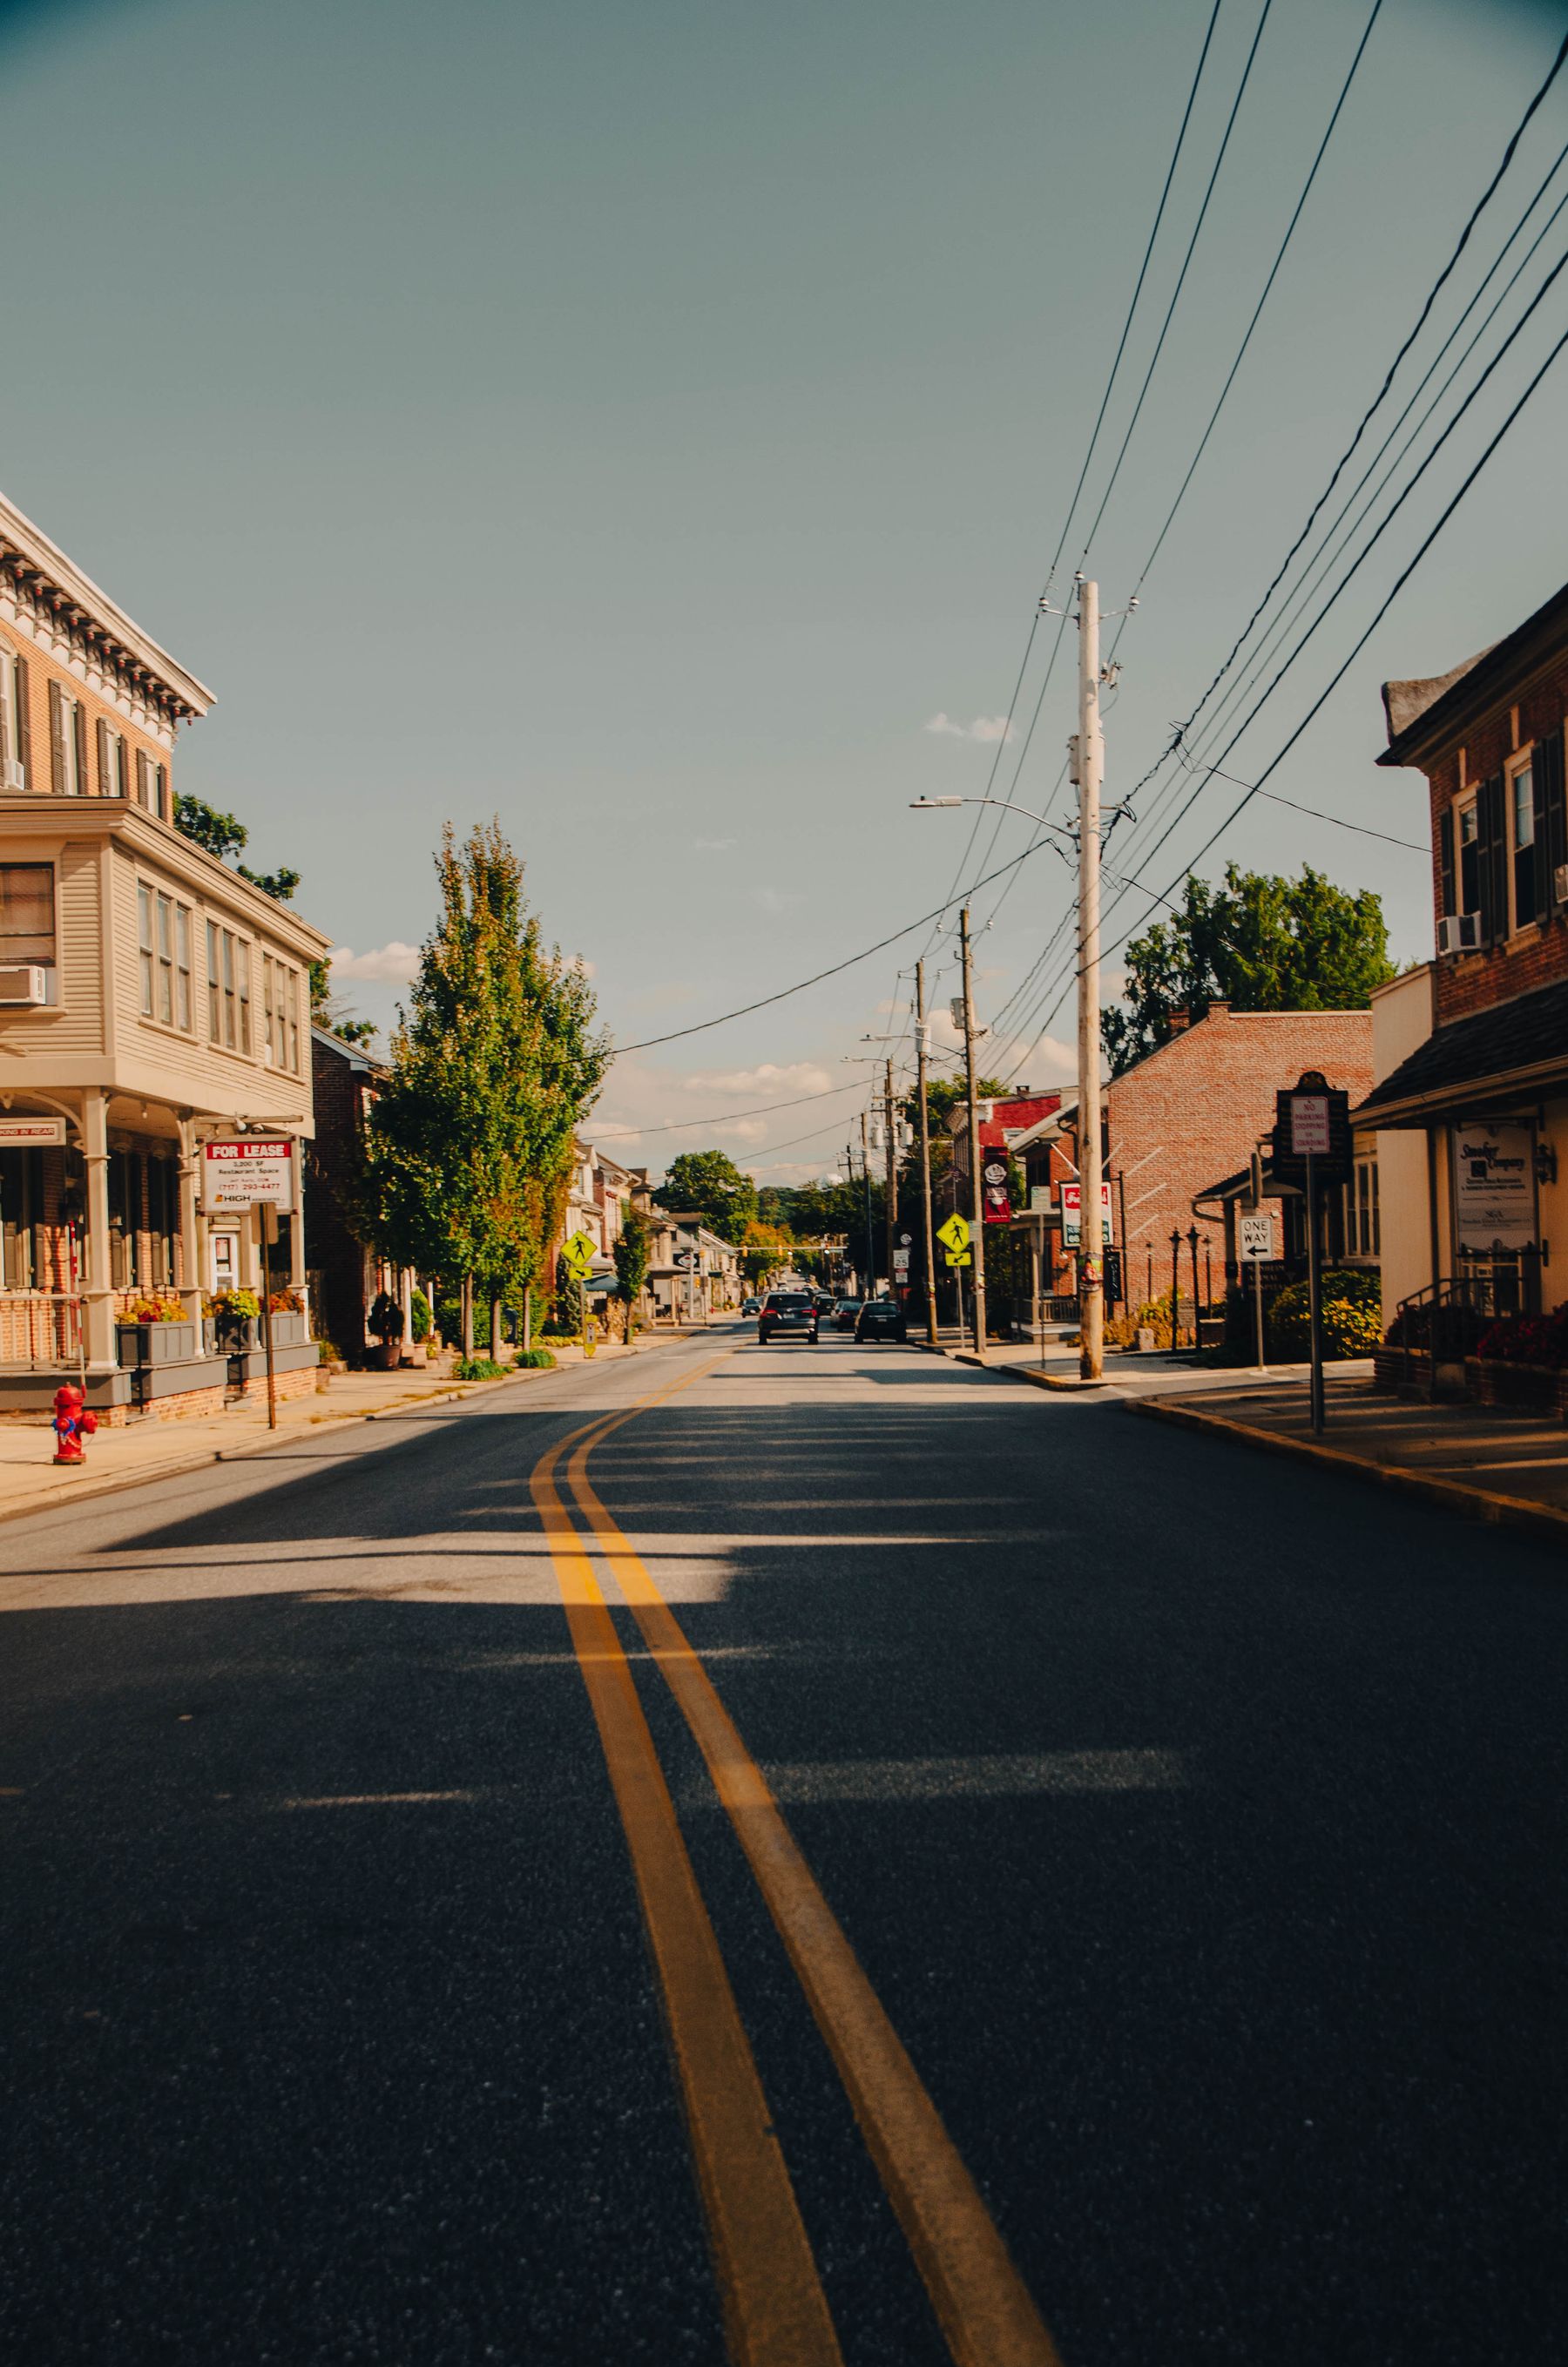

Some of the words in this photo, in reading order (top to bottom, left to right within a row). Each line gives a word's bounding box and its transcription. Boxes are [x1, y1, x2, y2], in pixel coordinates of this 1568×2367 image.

[213, 1146, 239, 1158] FOR
[244, 1145, 285, 1157] LEASE
[1244, 1221, 1267, 1231] ONE
[1244, 1233, 1267, 1243] WAY
